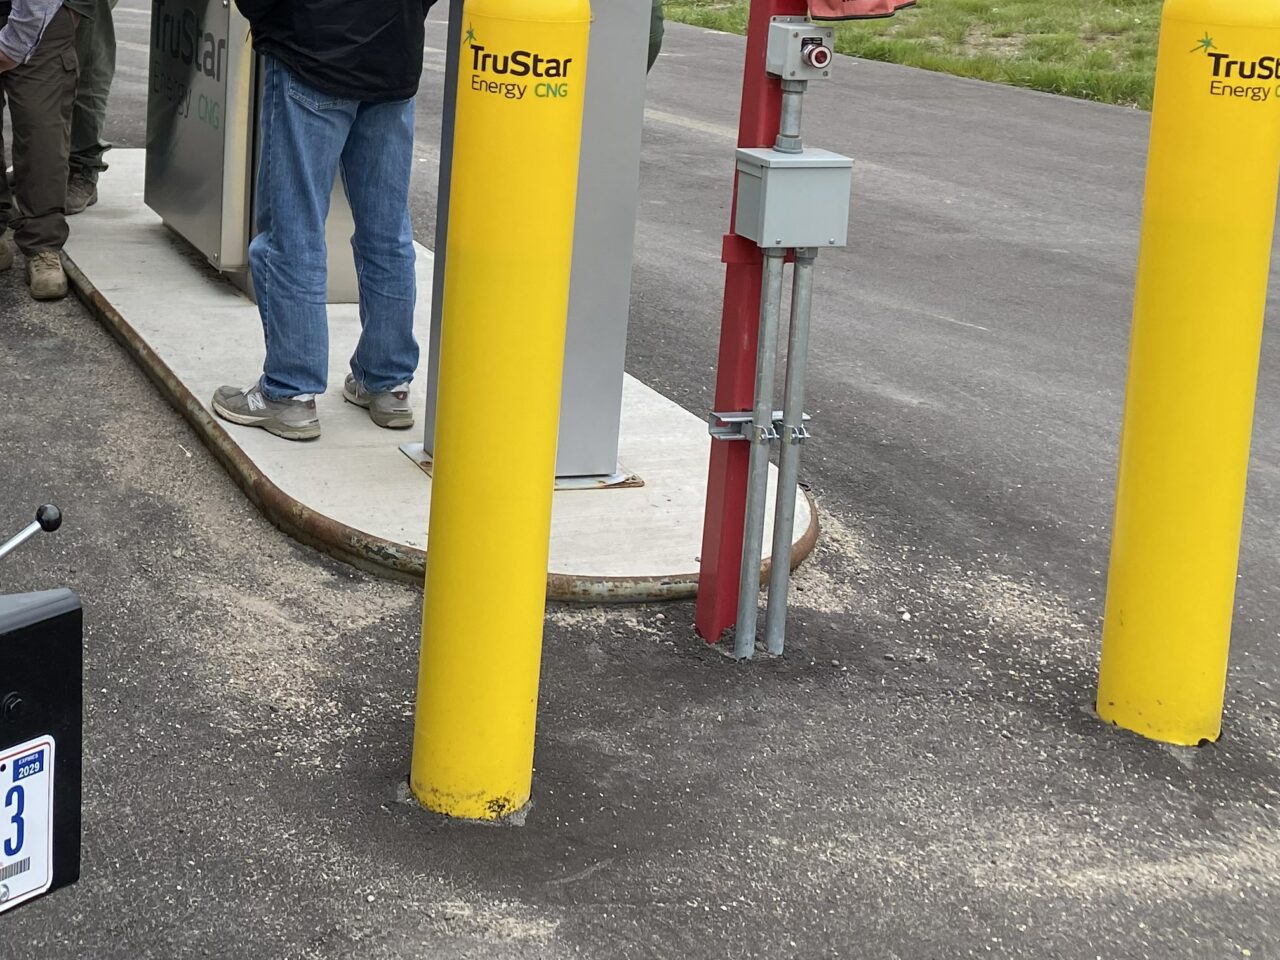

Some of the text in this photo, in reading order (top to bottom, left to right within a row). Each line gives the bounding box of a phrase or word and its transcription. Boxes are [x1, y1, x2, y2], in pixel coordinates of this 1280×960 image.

[470, 44, 573, 78] TruStar
[153, 60, 221, 130] Energy CNG
[471, 74, 568, 100] Energy CNG
[1209, 80, 1271, 102] Energy
[18, 753, 39, 765] EXPIRES
[18, 761, 40, 778] 2029
